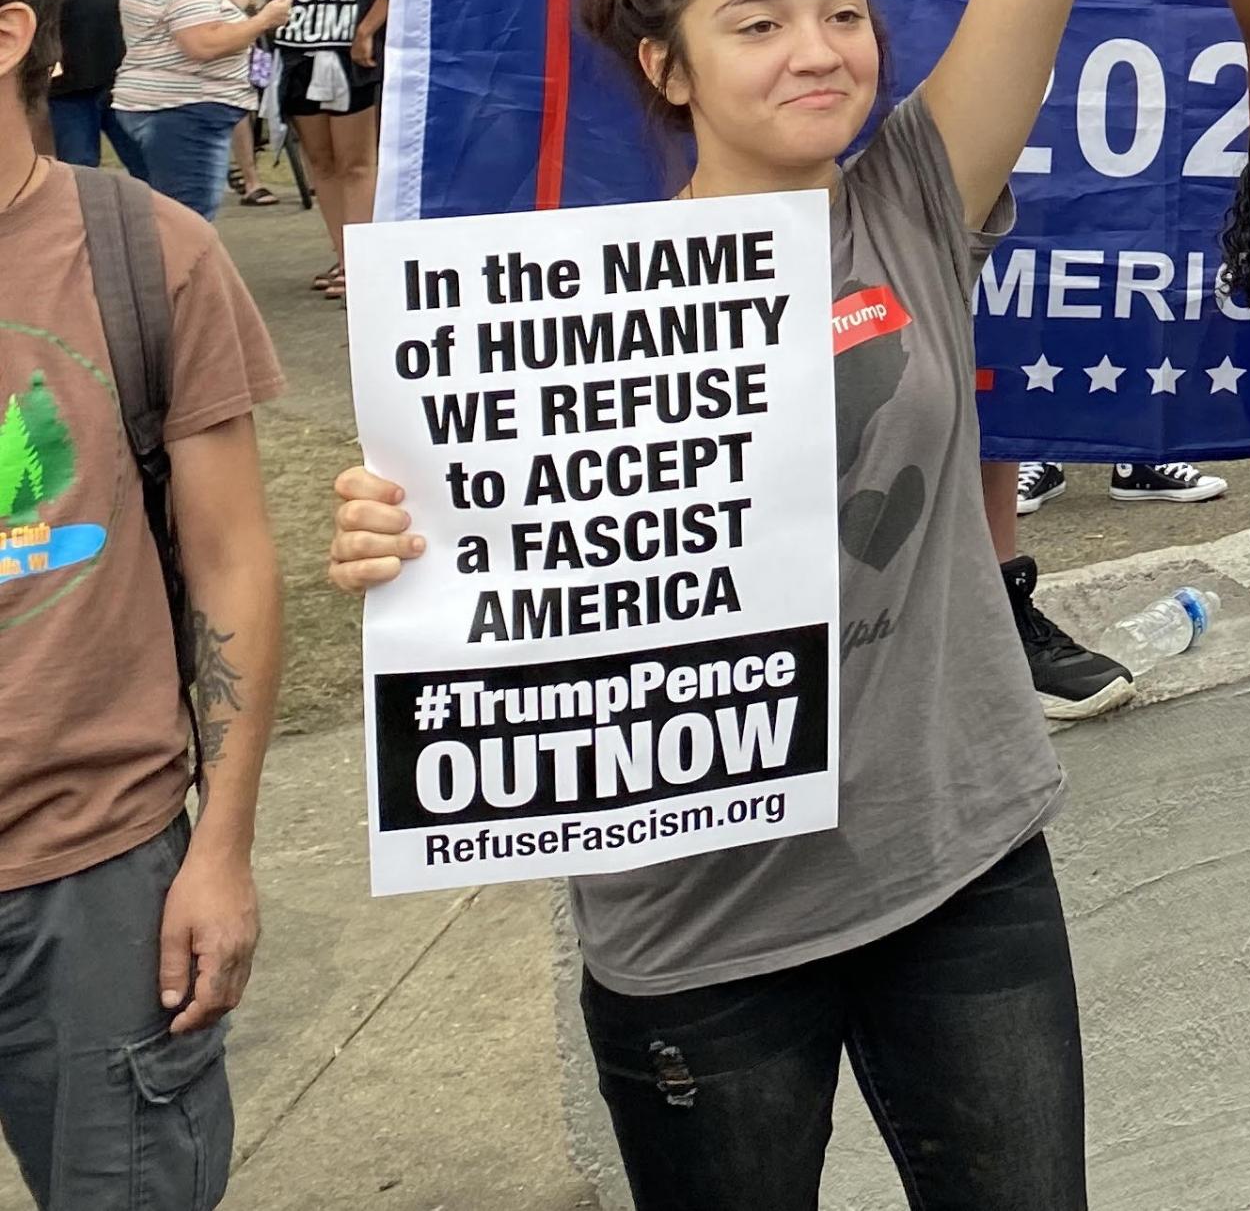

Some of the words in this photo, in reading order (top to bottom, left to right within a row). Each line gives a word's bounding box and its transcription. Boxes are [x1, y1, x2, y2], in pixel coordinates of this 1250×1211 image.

[404, 260, 460, 311] In
[482, 252, 580, 303] the
[602, 230, 776, 295] NAME
[395, 327, 456, 380] of
[477, 295, 790, 374] HUMANITY
[832, 303, 888, 334] Trump
[422, 389, 518, 445] WE
[541, 363, 769, 436] REFUSE
[446, 461, 505, 509] to
[523, 432, 753, 507] ACCEPT
[456, 534, 490, 573] a
[511, 498, 753, 572] FASCIST
[467, 566, 742, 644] AMERICA
[414, 649, 797, 731] #TrumpPence
[415, 695, 800, 814] OUTNOW
[425, 790, 787, 866] RefuseFascism.org
